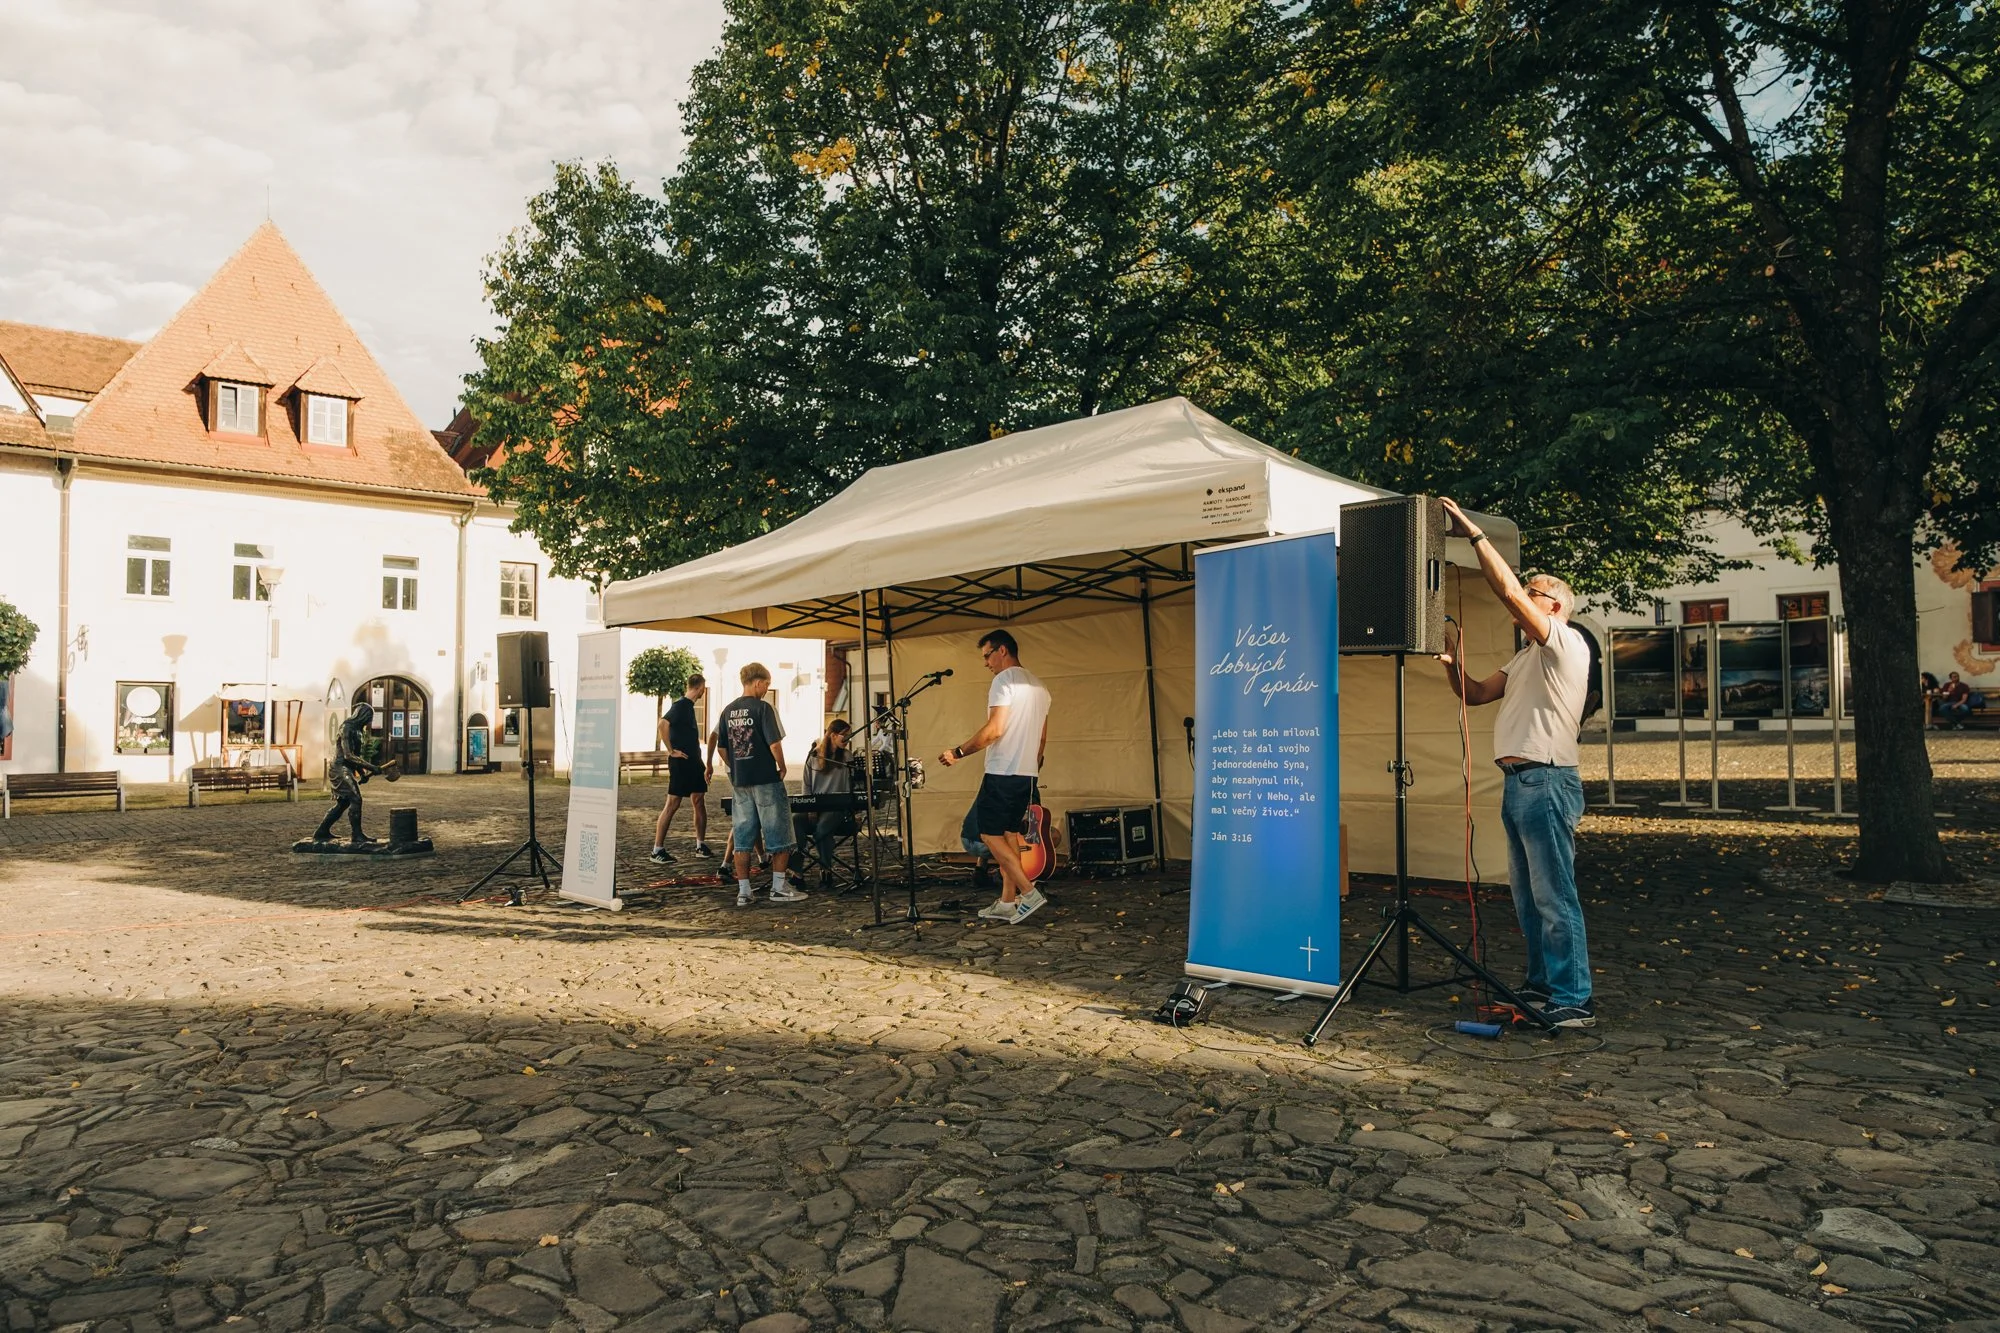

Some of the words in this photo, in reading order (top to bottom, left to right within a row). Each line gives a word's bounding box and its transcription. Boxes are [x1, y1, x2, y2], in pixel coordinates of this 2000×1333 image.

[1218, 483, 1246, 494] ekspand
[1235, 624, 1291, 647] Večer
[1210, 649, 1287, 695] dobrých
[1261, 672, 1319, 707] správ
[1242, 729, 1258, 738] tak
[1262, 728, 1279, 737] Boh
[1283, 727, 1320, 737] miloval
[1212, 744, 1237, 755] svet,
[1242, 744, 1252, 753] že
[1257, 743, 1273, 753] dal
[1278, 744, 1310, 755] svojho
[1212, 759, 1279, 771] jednorodeného
[1283, 760, 1309, 771] Syna,
[1211, 775, 1228, 785] aby
[1232, 775, 1278, 786] nezahynul
[1283, 776, 1304, 787] nik,
[1211, 790, 1228, 799] kto
[1232, 790, 1252, 800] verí
[1267, 791, 1294, 803] Neho,
[1299, 792, 1316, 802] ale
[1211, 805, 1228, 815] mal
[1232, 806, 1257, 817] večný
[1211, 831, 1227, 841] Ján
[1232, 833, 1252, 842] 3:16
